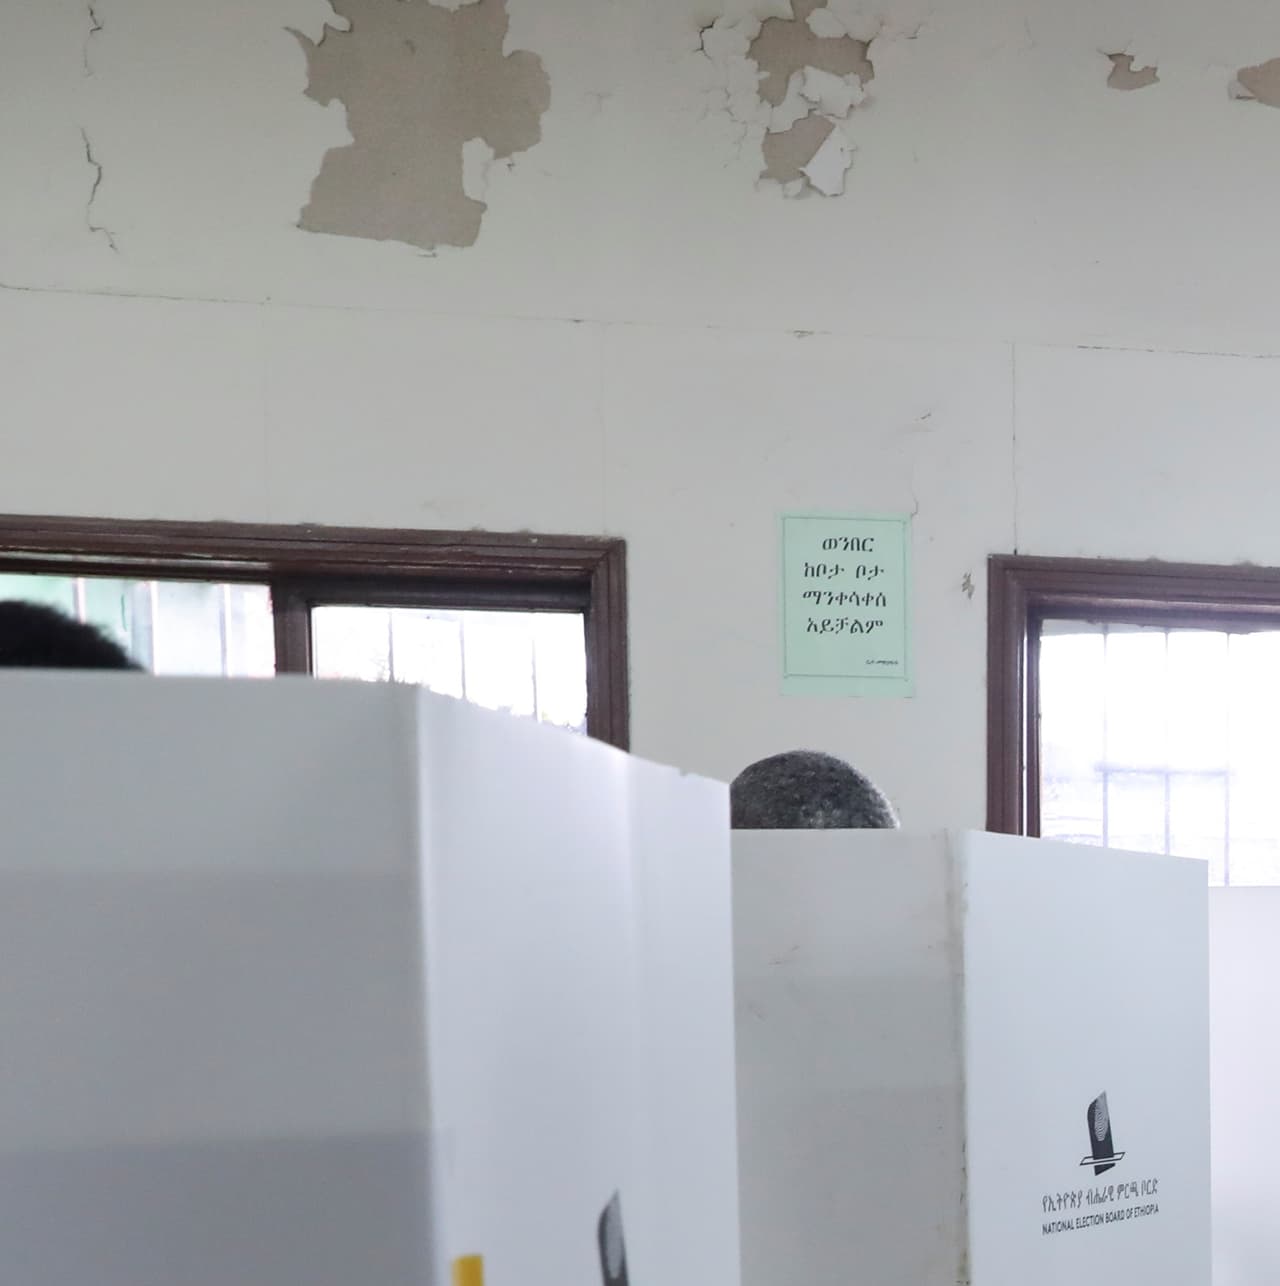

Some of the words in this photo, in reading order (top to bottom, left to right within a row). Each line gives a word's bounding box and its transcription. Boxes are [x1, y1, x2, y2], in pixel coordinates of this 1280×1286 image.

[822, 537, 874, 552] ወንበር
[804, 562, 845, 580] ከቦታ
[856, 564, 884, 581] ቦታ
[802, 590, 887, 607] ማንቀሳቀስ
[806, 617, 883, 634] አይቻልም
[1042, 1219, 1074, 1236] NATIONAL
[1075, 1213, 1104, 1230] ELECTION
[1105, 1209, 1125, 1224] BOARD
[1125, 1207, 1134, 1220] OF
[1134, 1203, 1159, 1219] ETHIOPIA
